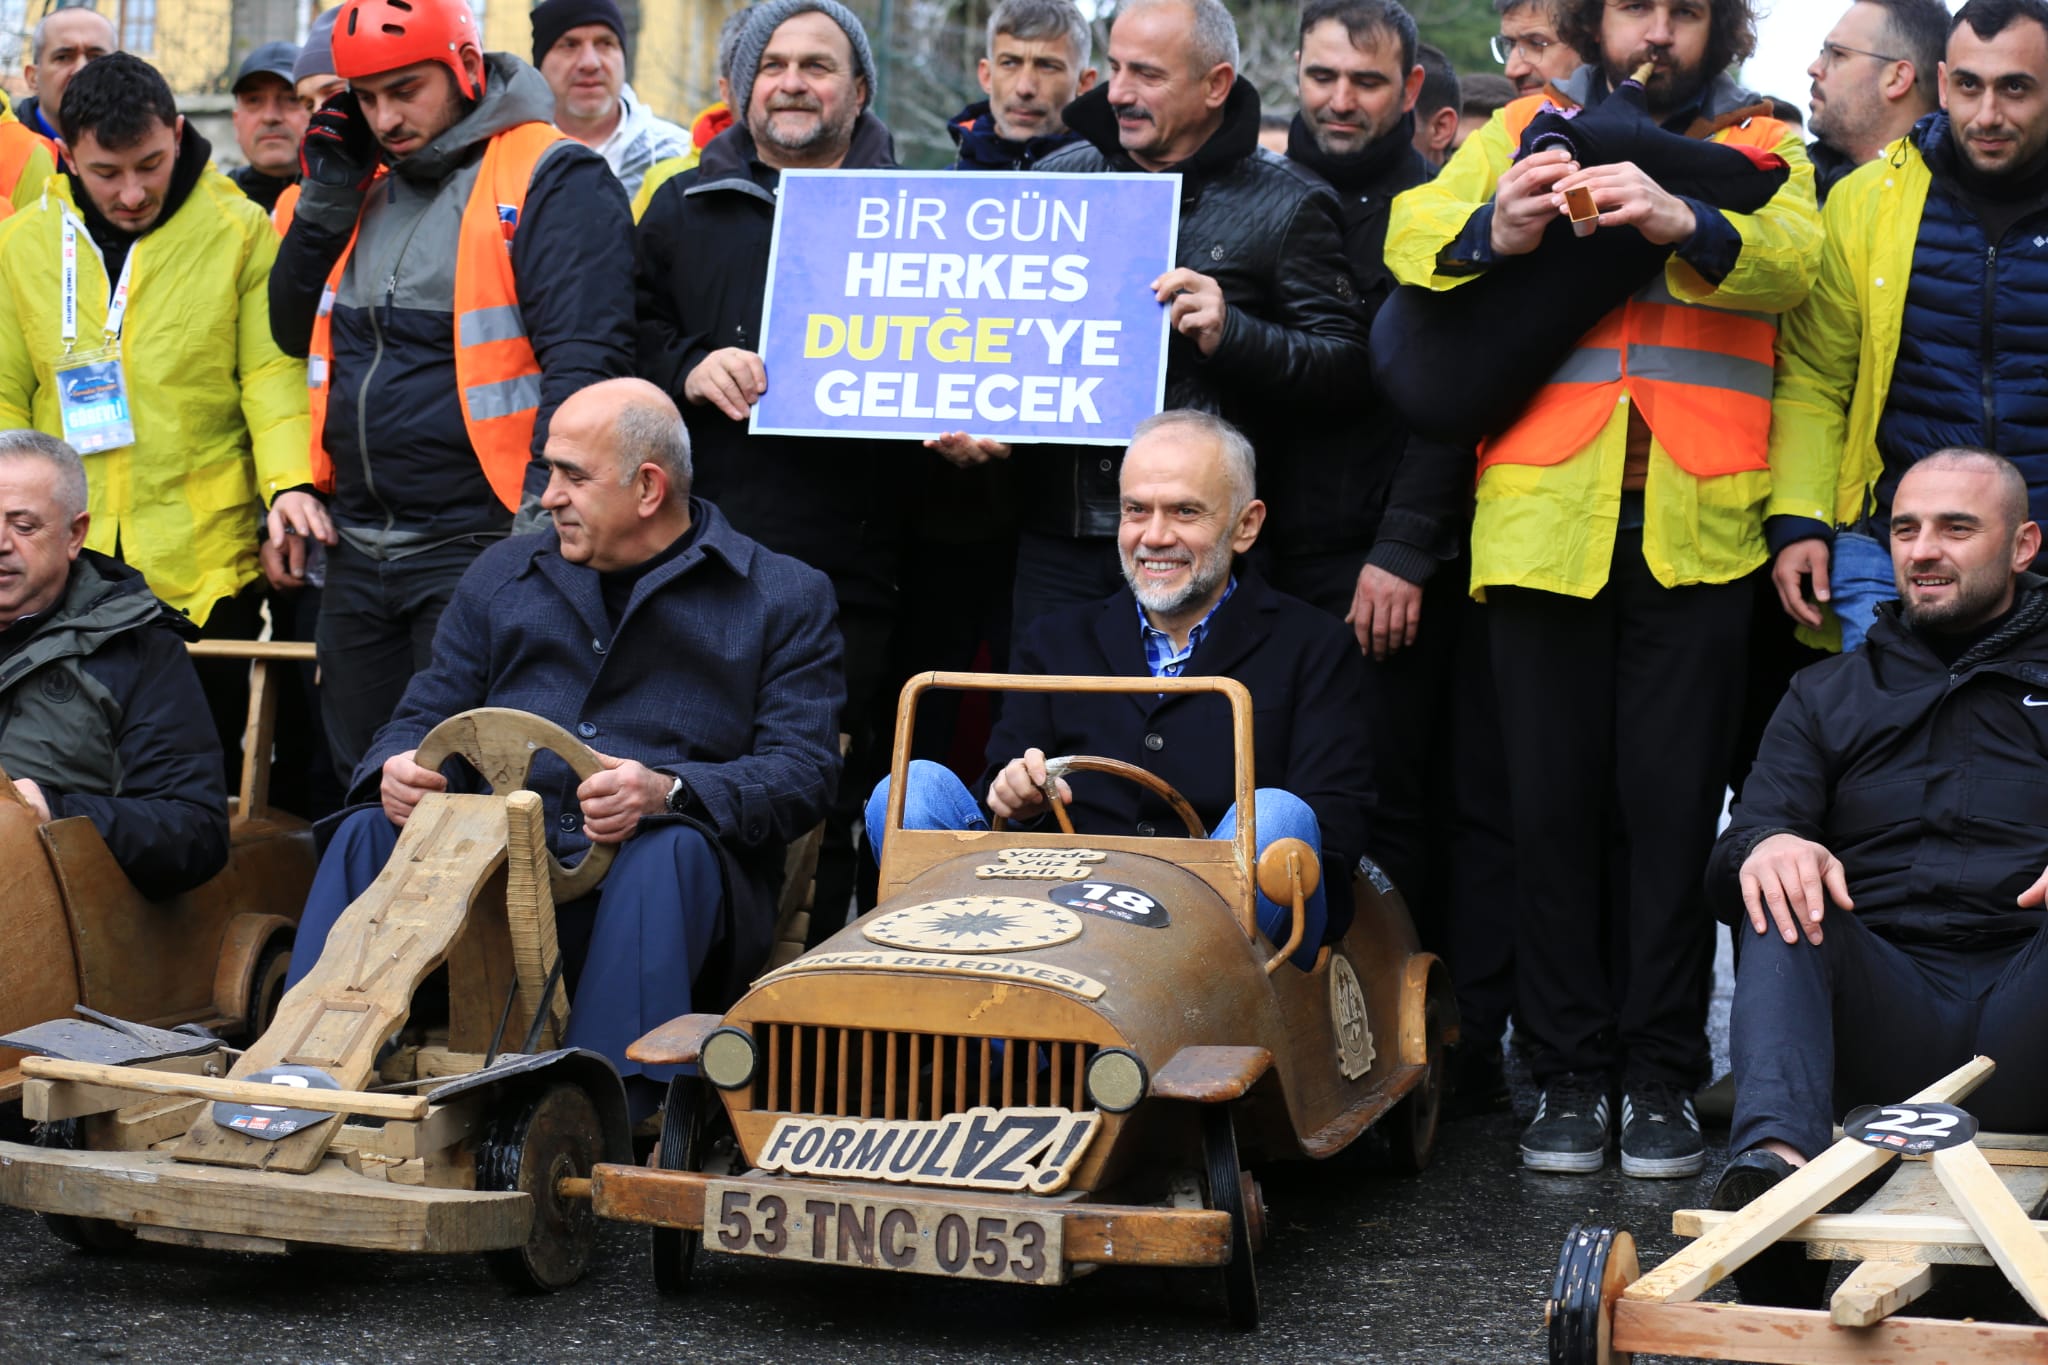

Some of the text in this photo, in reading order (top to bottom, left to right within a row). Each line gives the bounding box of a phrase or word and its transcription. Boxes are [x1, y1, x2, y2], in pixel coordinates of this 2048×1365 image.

[855, 189, 1090, 243] BİR GÜN
[843, 251, 1091, 303] HERKES
[803, 307, 1123, 367] DUTĞE'YE
[813, 368, 1104, 424] GELECEK
[1082, 883, 1156, 915] 18
[893, 955, 1088, 991] BELEDİYESİ
[1864, 1108, 1960, 1138] 22
[717, 1190, 1047, 1282] 53 TNC 053
